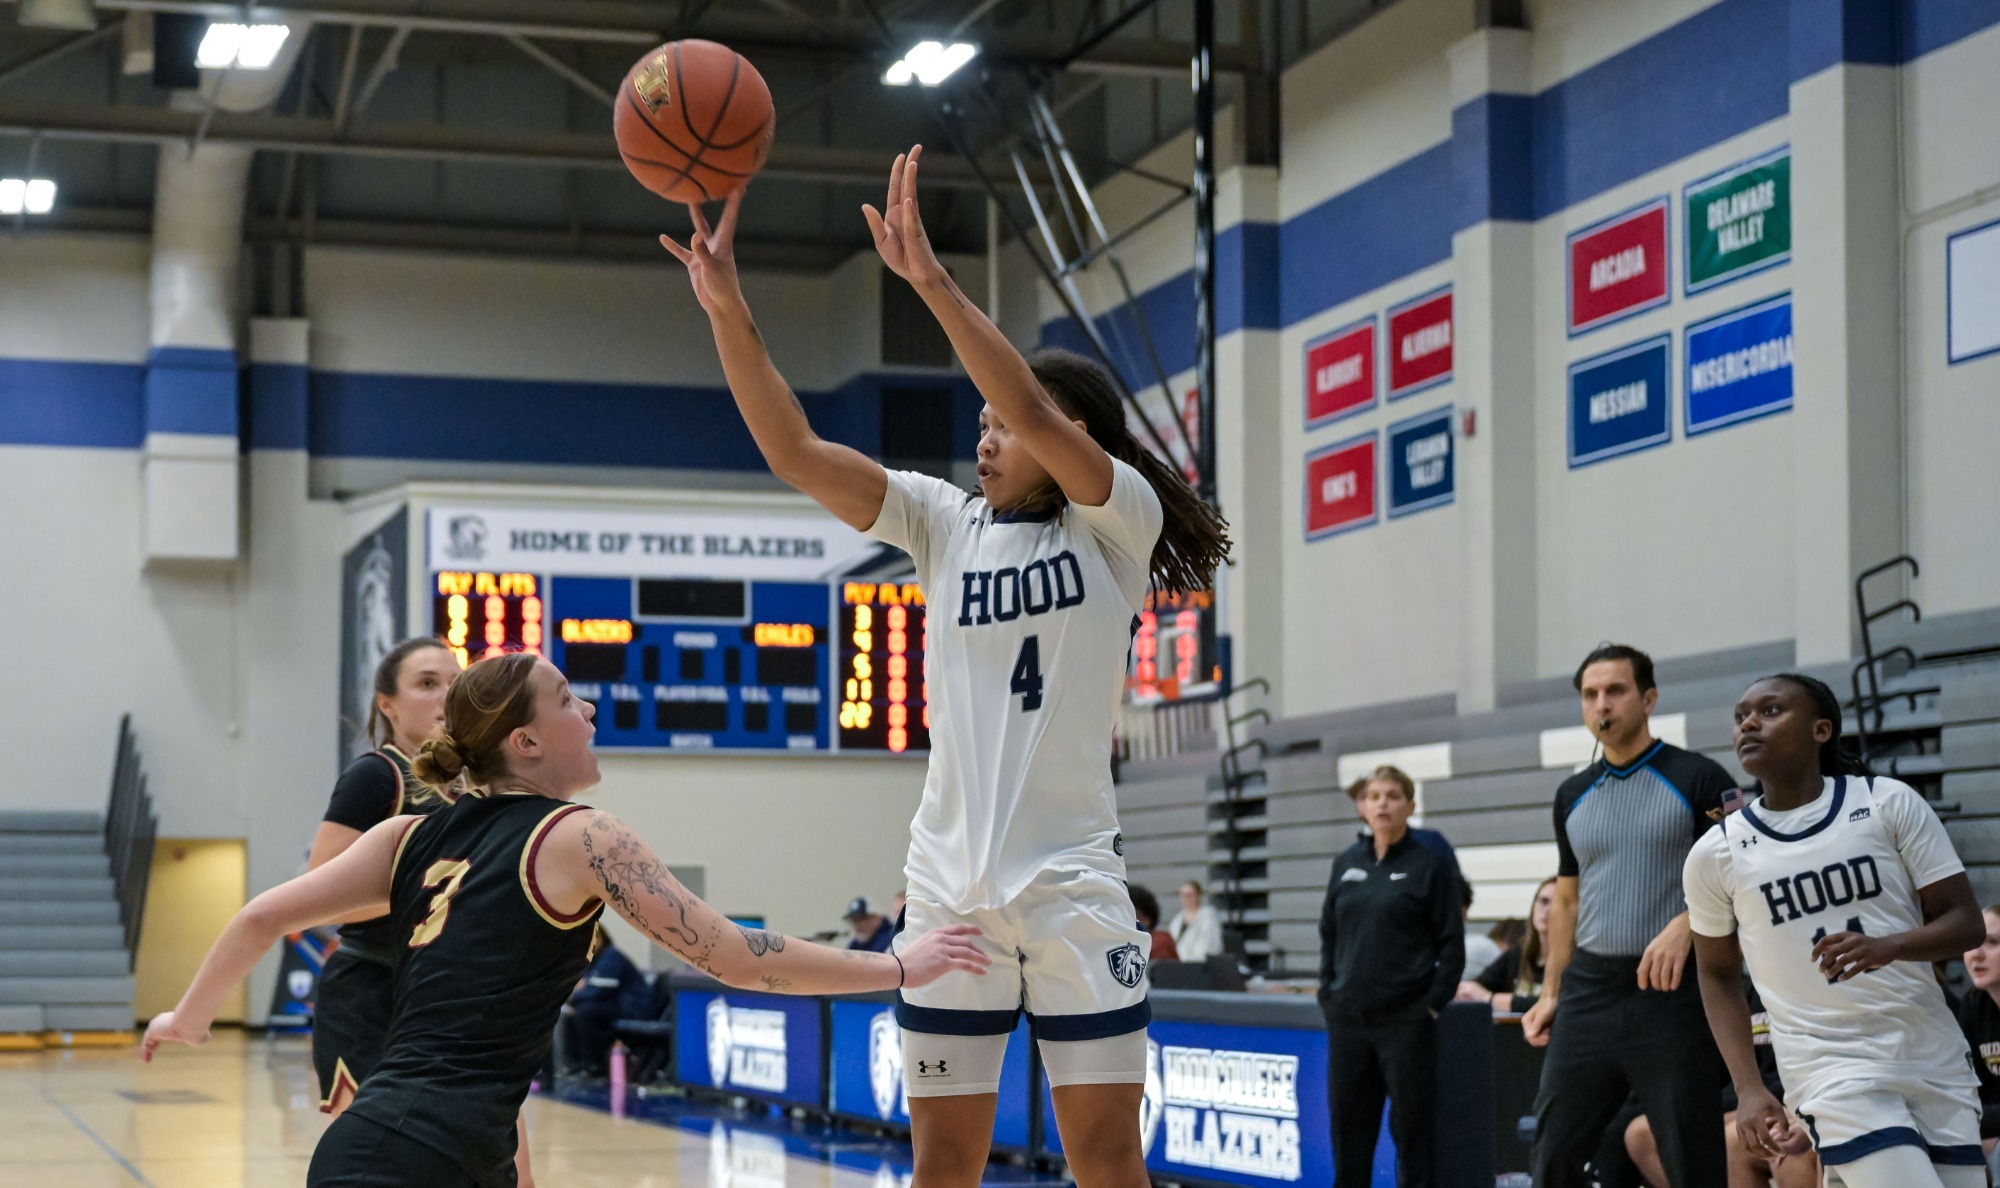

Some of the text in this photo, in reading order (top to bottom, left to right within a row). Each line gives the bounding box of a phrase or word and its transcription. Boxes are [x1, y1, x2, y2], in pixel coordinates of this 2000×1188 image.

[1706, 178, 1776, 232] DELAWARE
[1717, 211, 1766, 256] VALLEY
[1589, 243, 1647, 293] ARCADIA
[1690, 332, 1795, 395] MISERICORDIA
[1589, 378, 1648, 425] MESSIAH
[509, 529, 826, 559] HOME OF THE BLAZERS
[958, 549, 1086, 627] HOOD
[1010, 634, 1044, 714] 4
[407, 857, 473, 949] 3
[1760, 854, 1884, 927] HOOD
[1162, 1045, 1300, 1119] HOOD COLLEGE
[1164, 1105, 1301, 1182] BLAZERS
